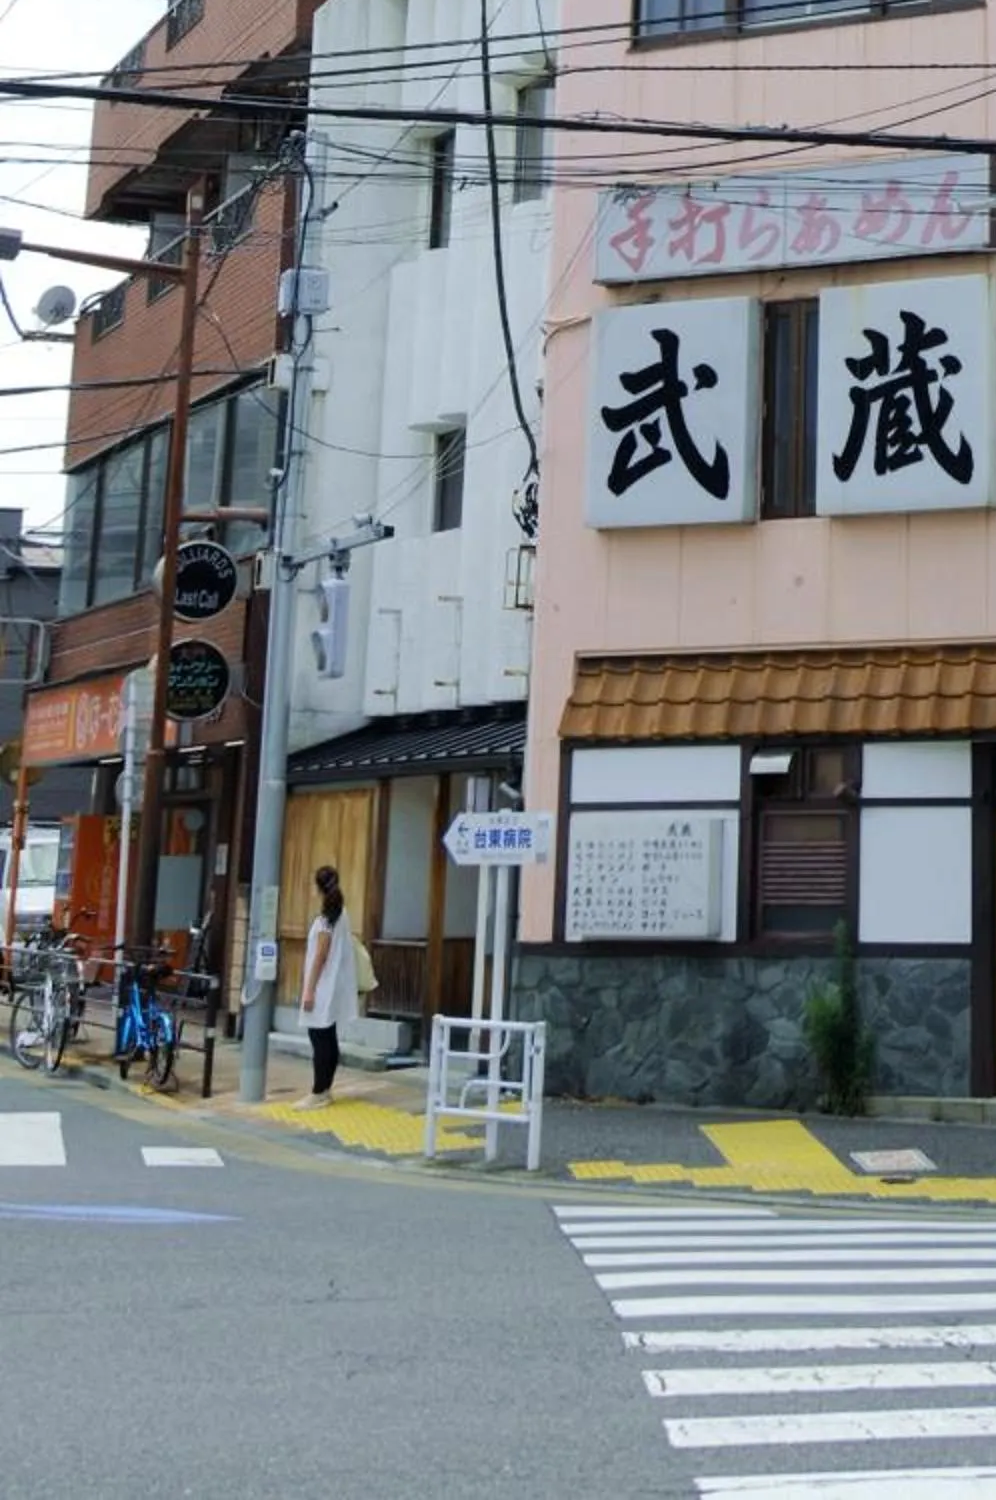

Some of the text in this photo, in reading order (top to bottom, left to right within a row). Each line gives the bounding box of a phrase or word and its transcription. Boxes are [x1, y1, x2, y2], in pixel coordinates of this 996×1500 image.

[610, 170, 973, 272] 手打らあめん
[474, 827, 532, 849] 台東病院
